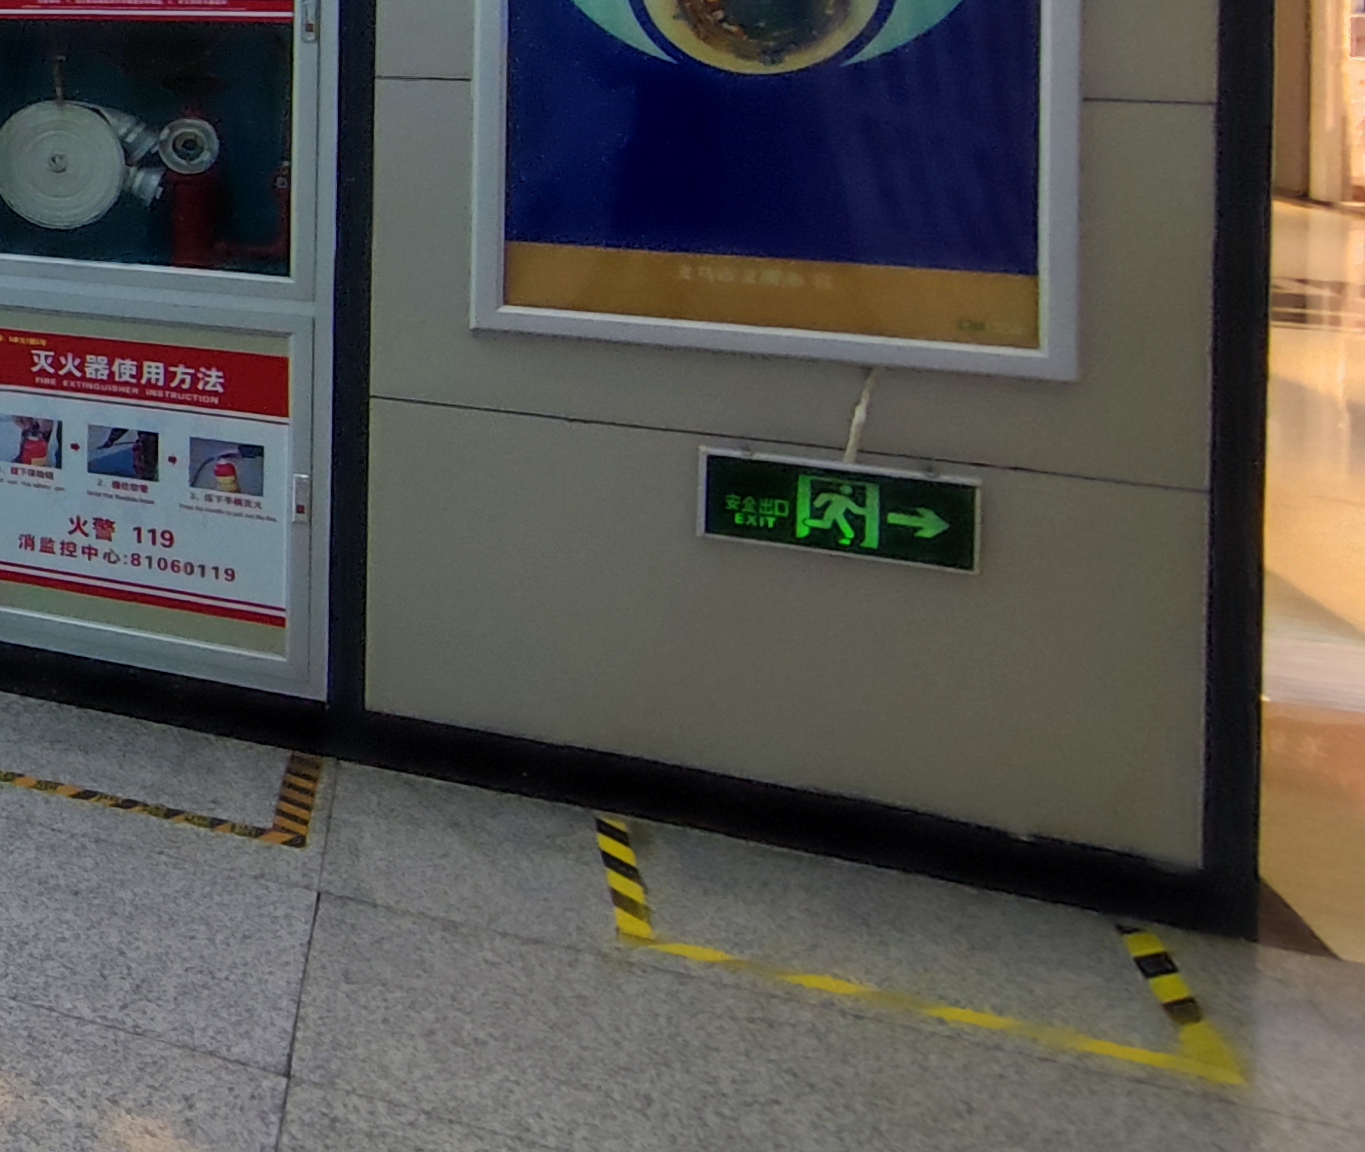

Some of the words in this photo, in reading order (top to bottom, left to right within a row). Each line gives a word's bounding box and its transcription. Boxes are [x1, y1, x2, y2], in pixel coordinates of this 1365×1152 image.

[29, 349, 226, 393] 灭火器使用方法
[35, 376, 57, 386] FIRE
[62, 380, 139, 395] EXTINGUISHER
[145, 388, 220, 405] INSTRUCTION
[725, 493, 789, 518] 安全出口
[735, 512, 777, 528] EXIT
[67, 514, 117, 543] 火警
[133, 526, 176, 549] 119
